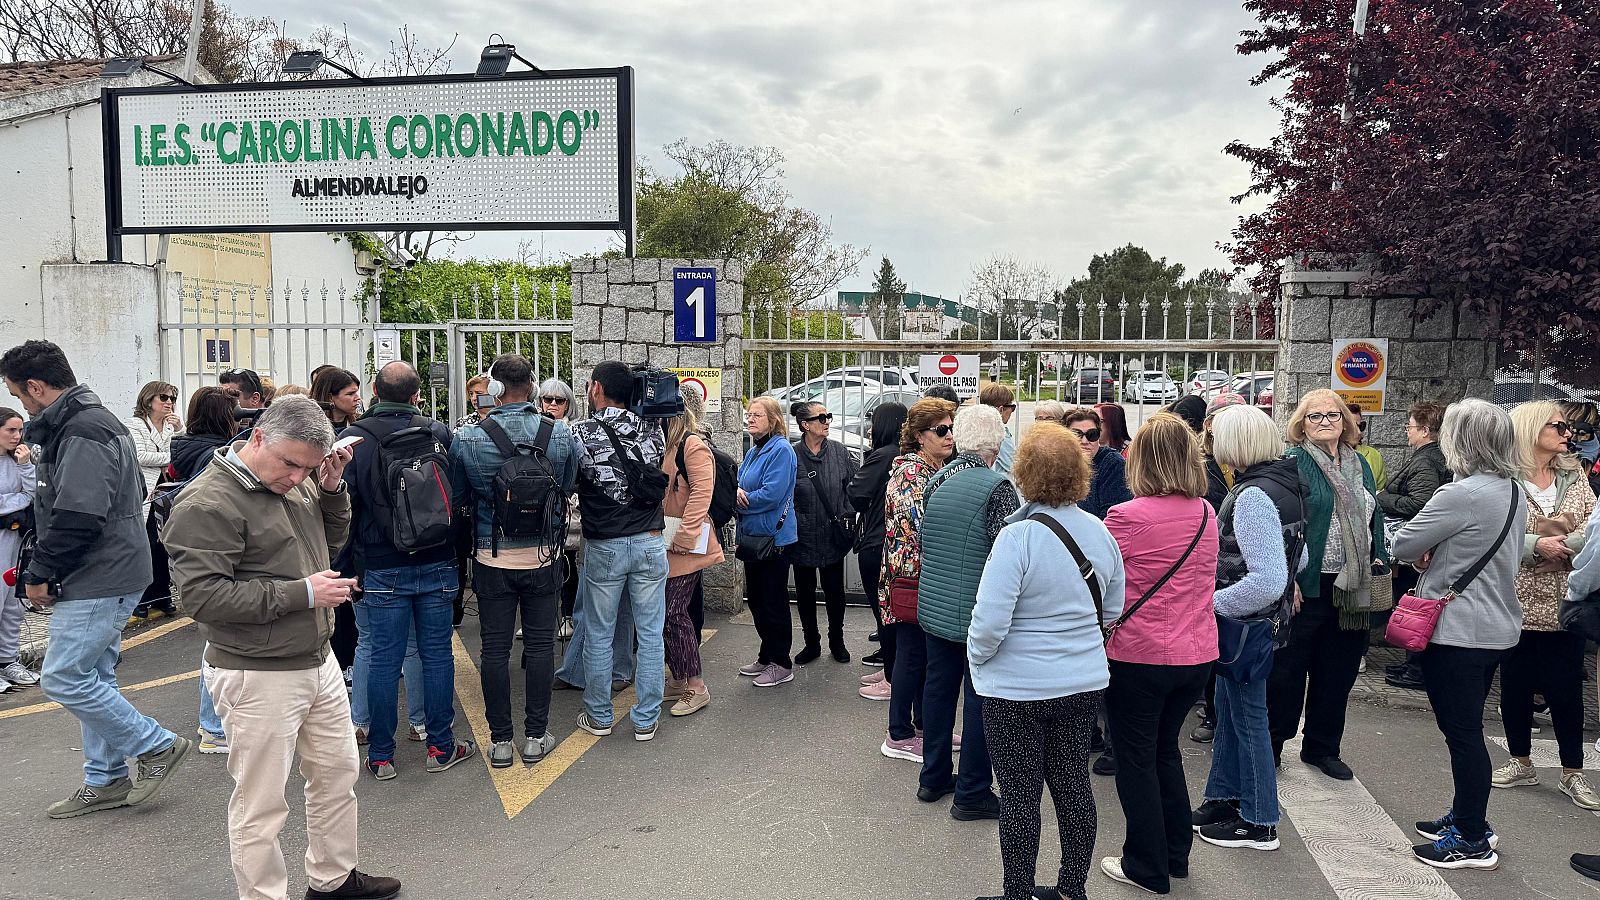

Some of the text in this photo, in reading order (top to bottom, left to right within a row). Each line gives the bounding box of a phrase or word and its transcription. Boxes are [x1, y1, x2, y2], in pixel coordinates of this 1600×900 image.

[134, 109, 600, 167] I.E.S. “CAROLINA CORONADO”
[291, 174, 428, 200] ALMENDRALEJO
[676, 272, 712, 280] ENTRADA
[685, 286, 705, 338] 1
[696, 370, 720, 378] ACCESO
[952, 376, 960, 387] EL
[961, 376, 977, 387] PASO
